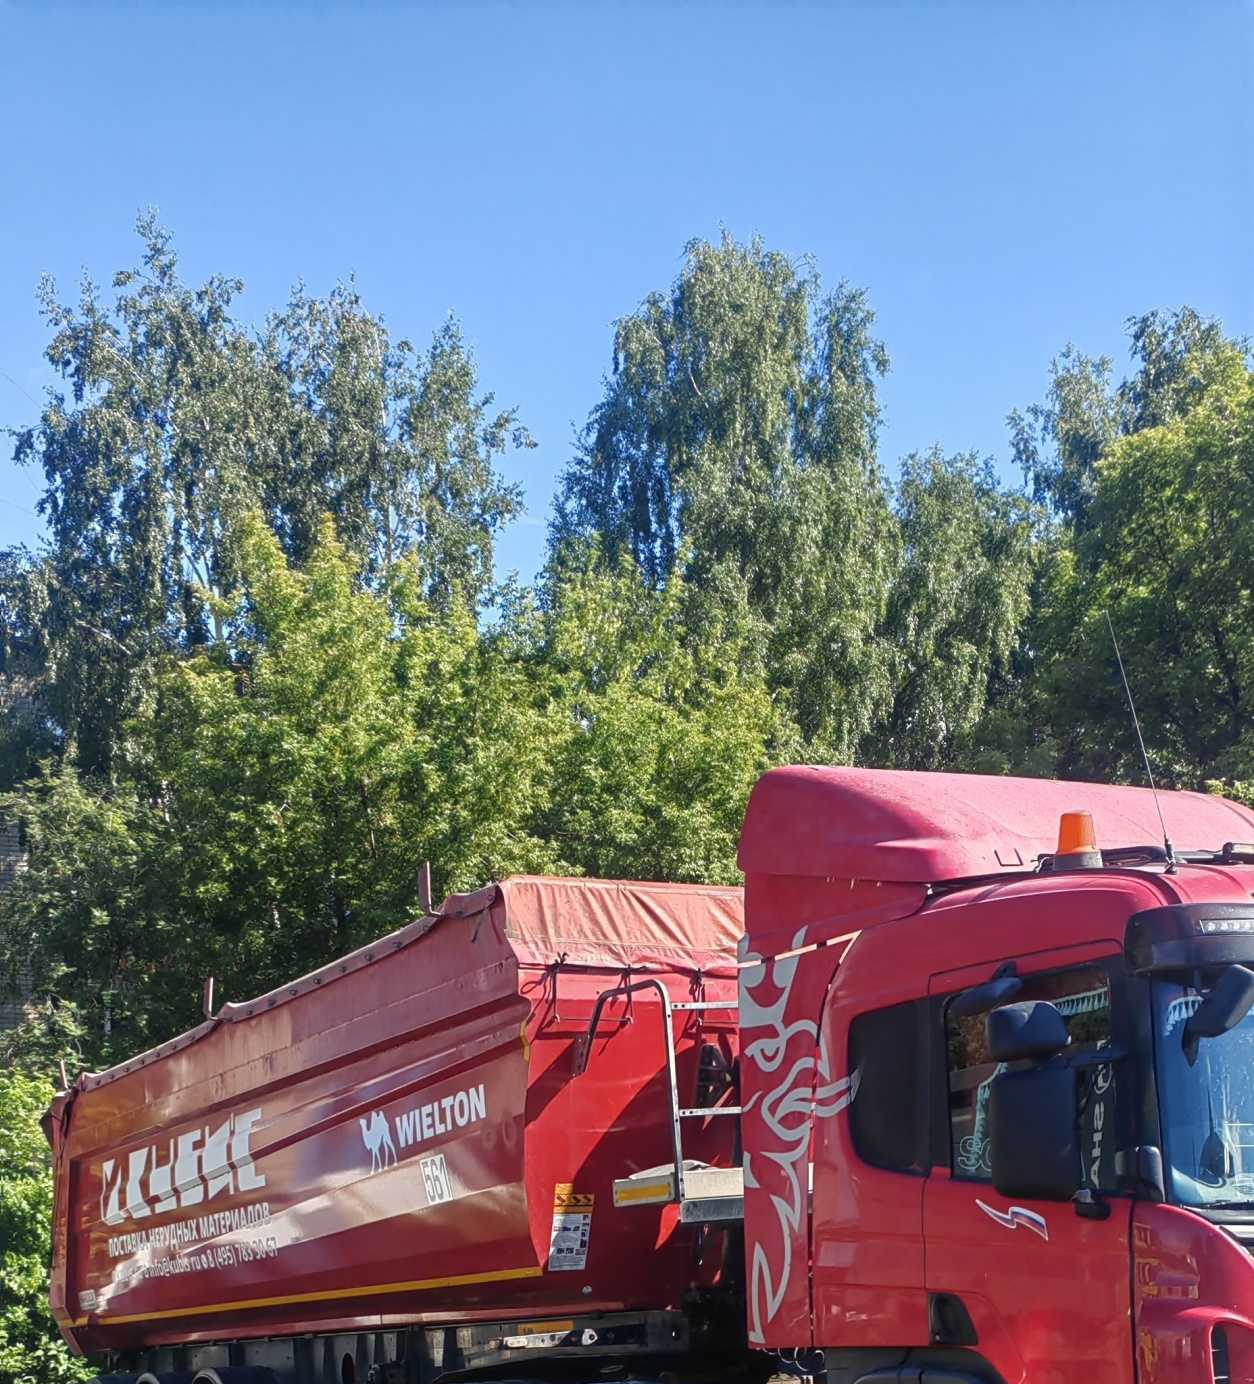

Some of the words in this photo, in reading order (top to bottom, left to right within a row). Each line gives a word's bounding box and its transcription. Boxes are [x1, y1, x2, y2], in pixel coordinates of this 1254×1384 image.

[395, 1084, 487, 1148] WIELTON
[421, 1156, 452, 1203] 561
[108, 1230, 149, 1258] ПОСТАВКА
[148, 1218, 199, 1250] НЕРУДНЫХ
[199, 1202, 273, 1239] МАТЕРИАЛОВ
[213, 1244, 238, 1270] (495)
